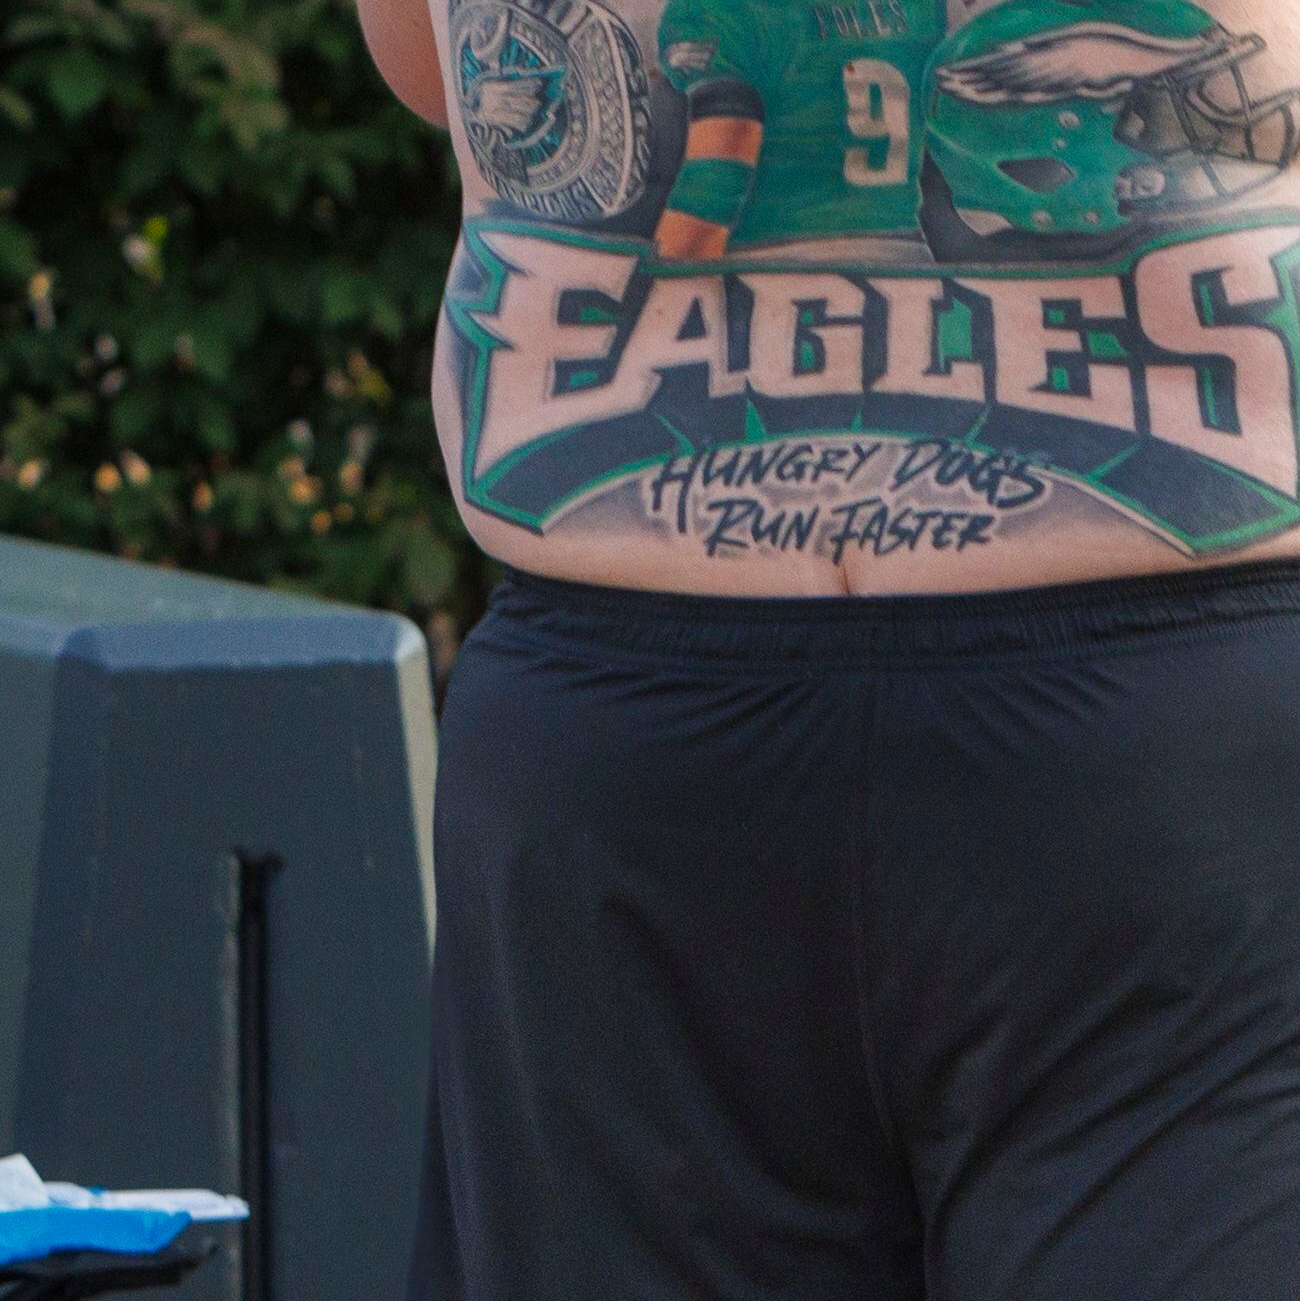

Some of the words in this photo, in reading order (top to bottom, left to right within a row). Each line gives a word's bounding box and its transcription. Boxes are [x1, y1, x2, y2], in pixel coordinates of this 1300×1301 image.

[842, 56, 911, 185] 9
[650, 439, 882, 533] HUNGRY
[705, 496, 819, 558] RUN
[831, 495, 996, 566] FASTER
